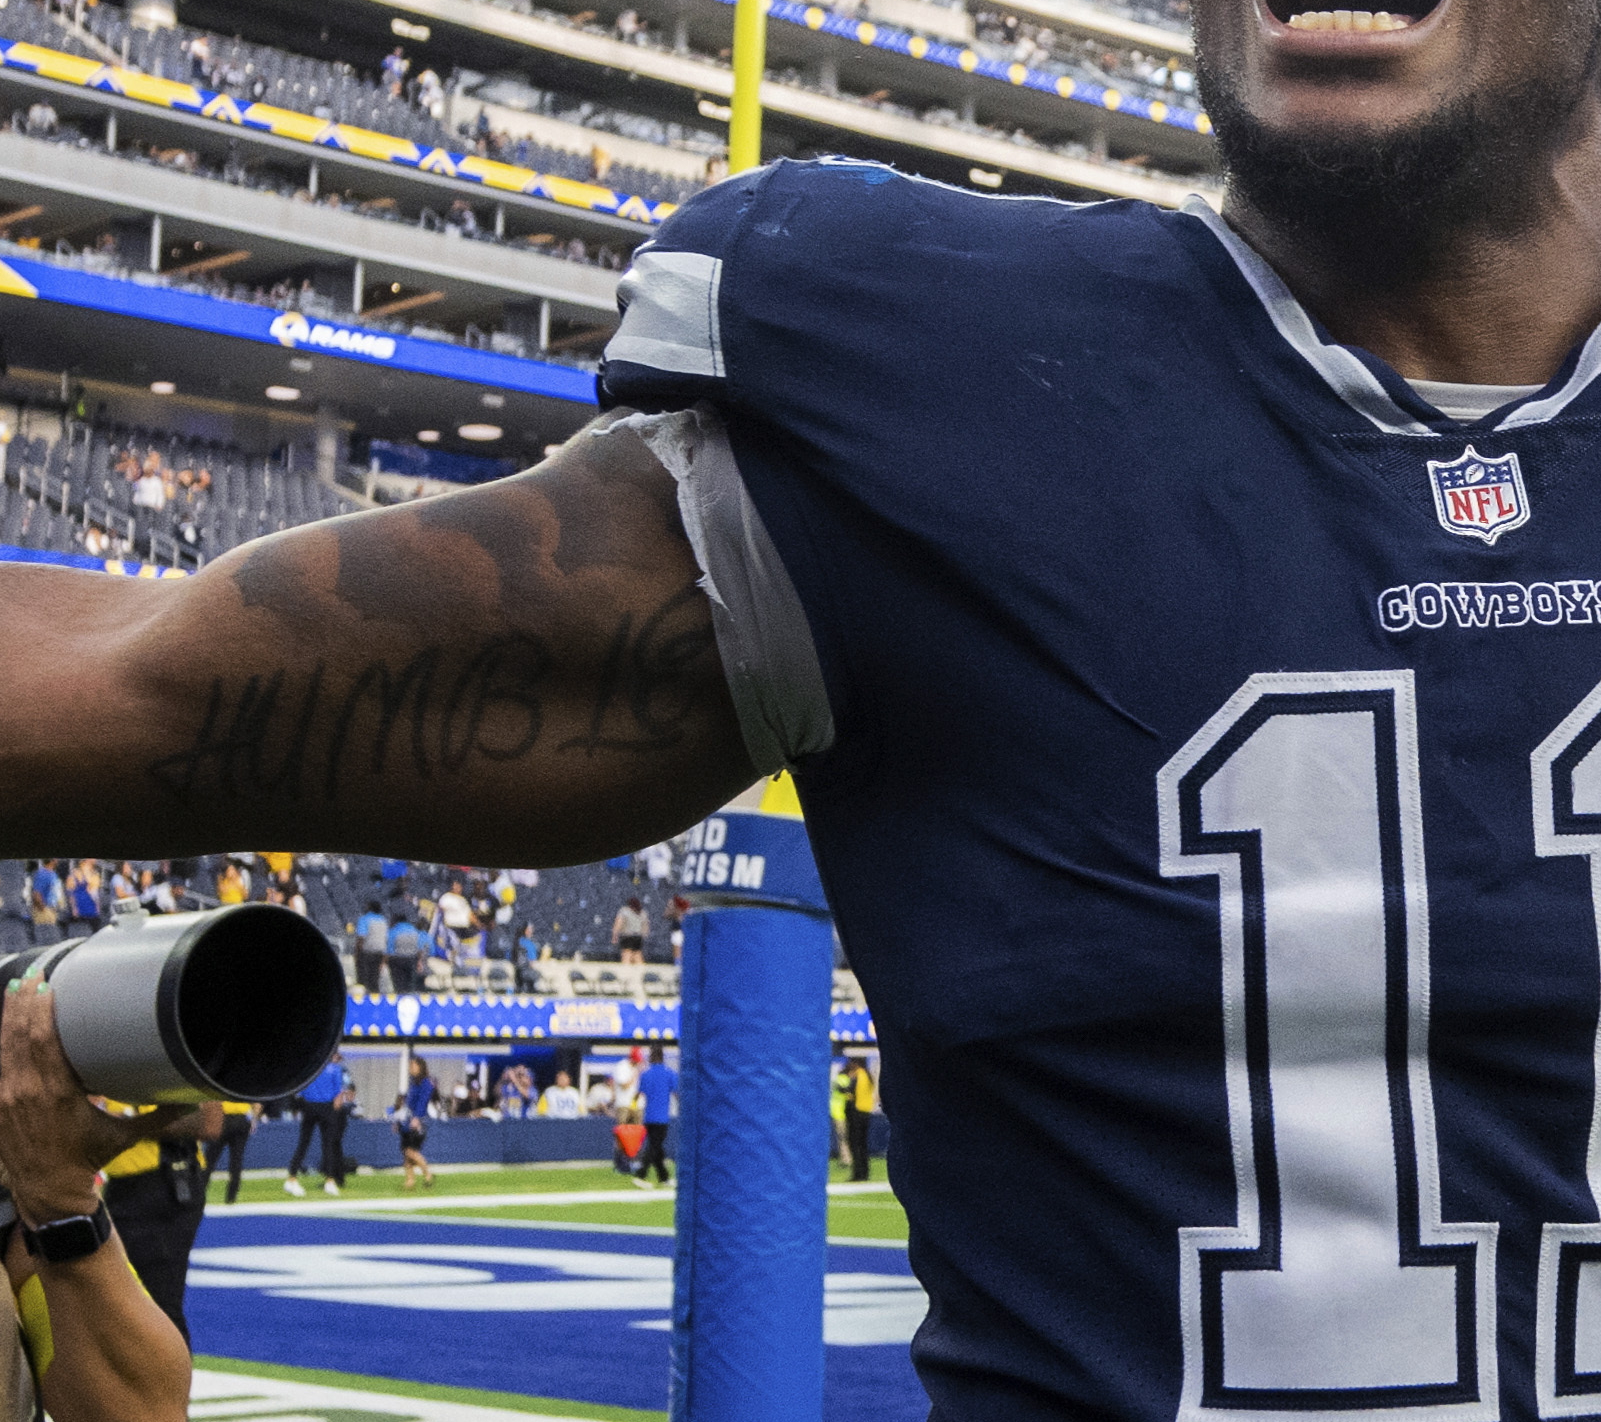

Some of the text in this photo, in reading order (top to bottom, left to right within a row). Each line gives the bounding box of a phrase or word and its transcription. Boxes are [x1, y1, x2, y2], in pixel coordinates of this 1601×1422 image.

[1446, 485, 1518, 527] NFL
[685, 818, 728, 852] ND
[681, 852, 766, 889] CISM
